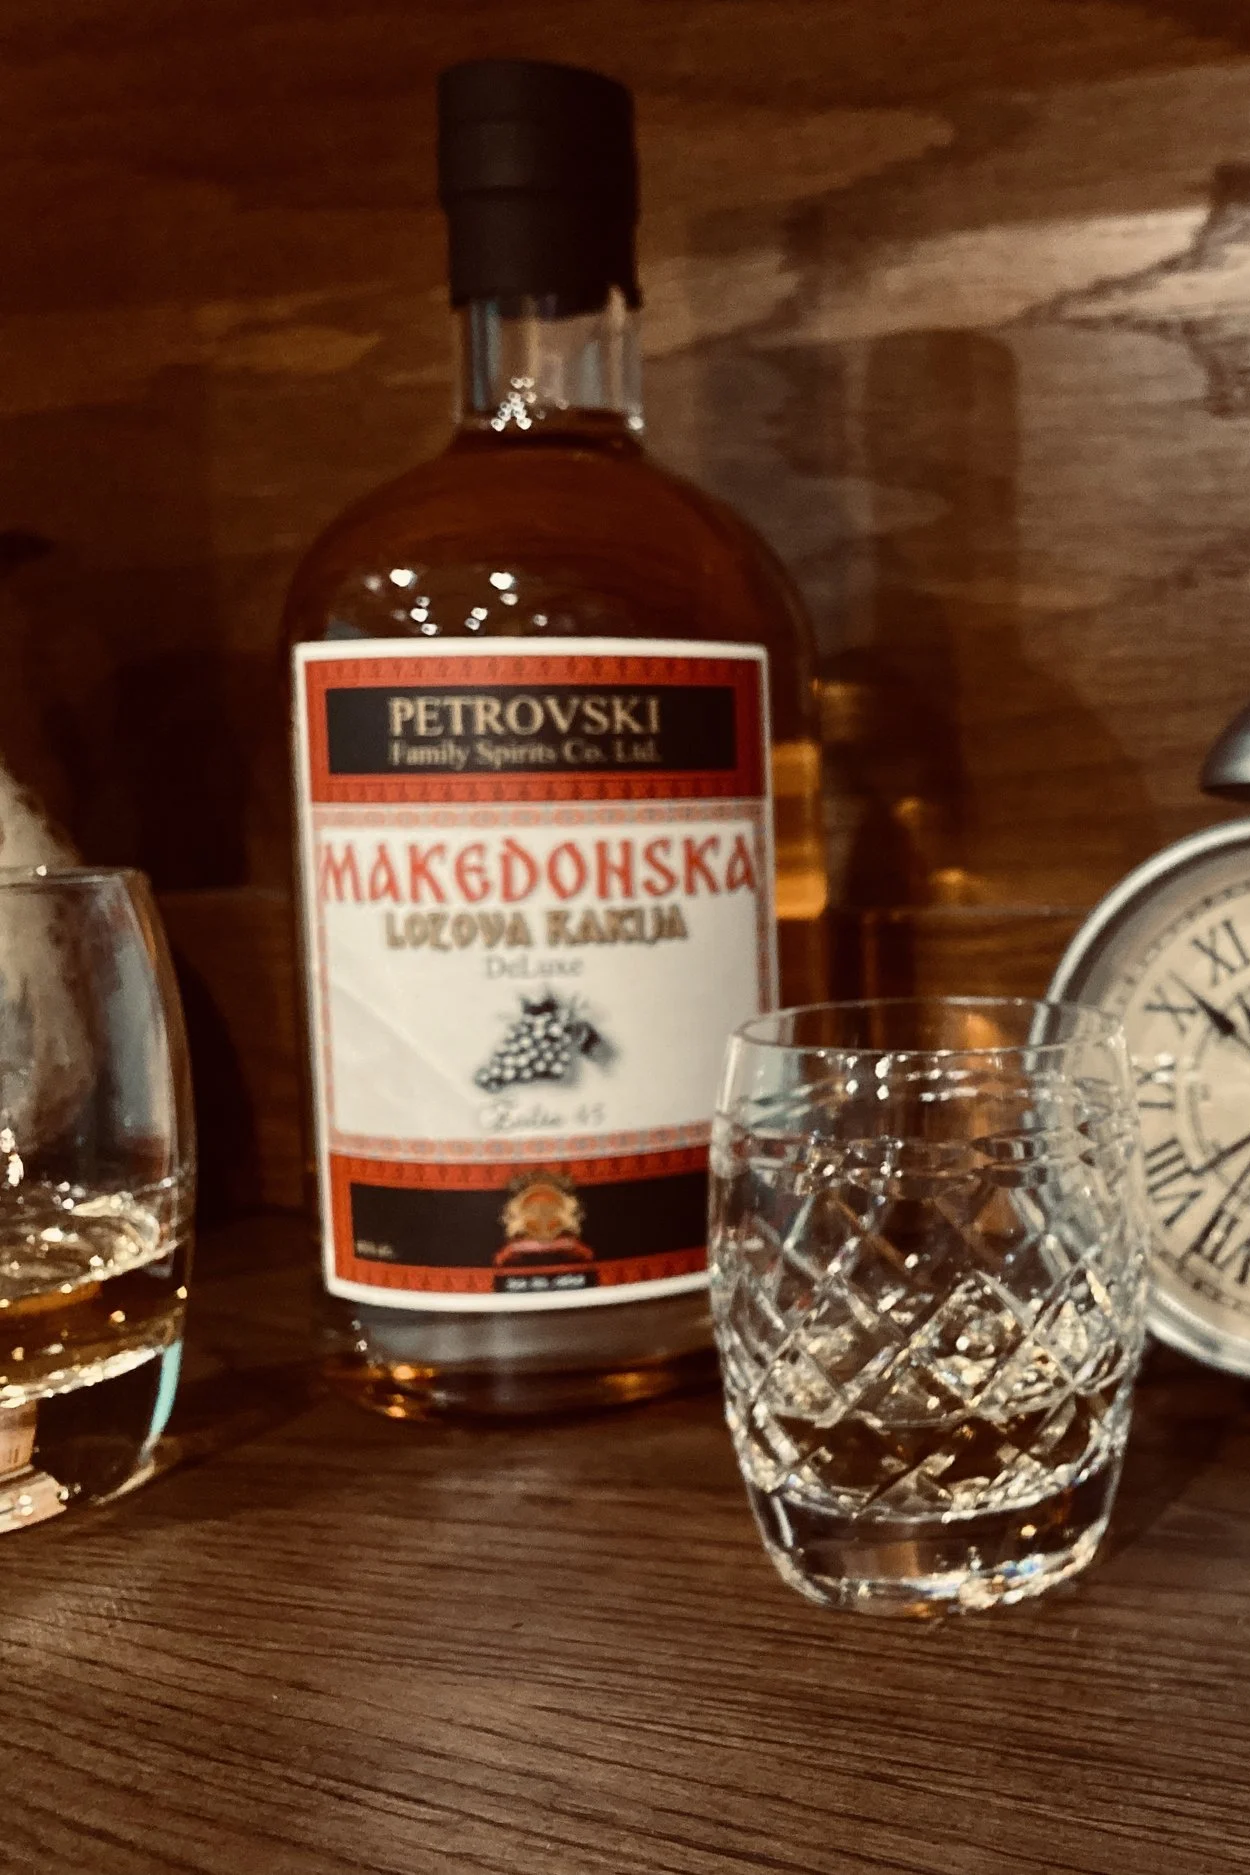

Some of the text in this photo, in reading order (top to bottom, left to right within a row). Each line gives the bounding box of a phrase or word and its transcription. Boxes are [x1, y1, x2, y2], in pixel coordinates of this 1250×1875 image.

[387, 694, 661, 737] PETROVSKI
[389, 739, 467, 771] Family
[475, 739, 558, 769] Spirits
[384, 906, 533, 950] LOZOVA
